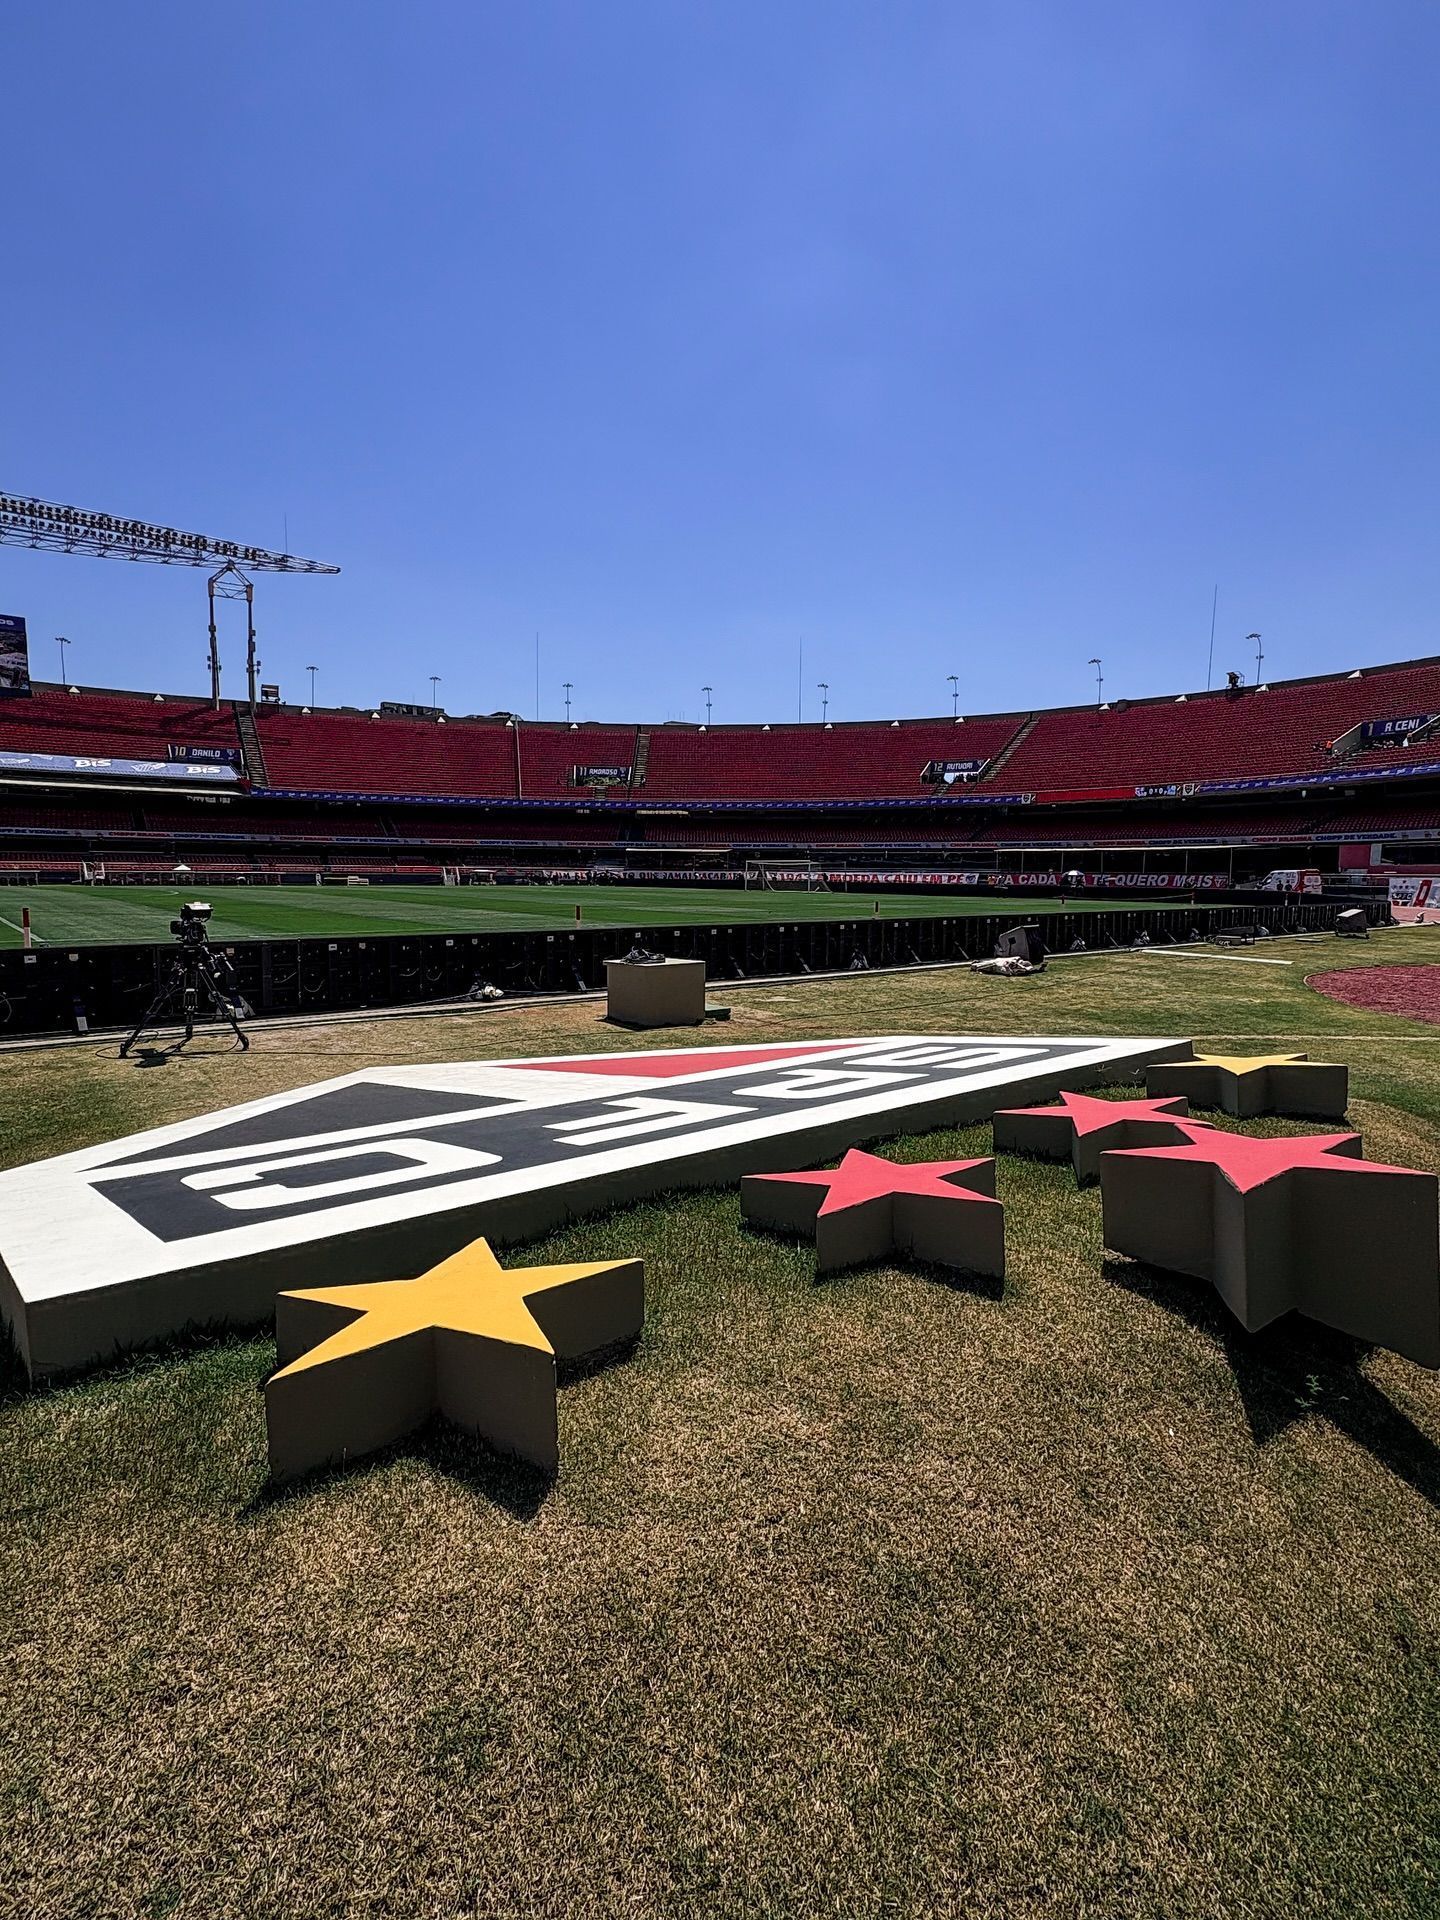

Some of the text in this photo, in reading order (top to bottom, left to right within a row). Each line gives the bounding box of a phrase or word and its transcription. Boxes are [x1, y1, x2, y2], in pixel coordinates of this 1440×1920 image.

[1368, 724, 1374, 736] 1
[1395, 719, 1420, 730] CENI
[174, 746, 187, 756] 10
[192, 749, 221, 758] DANILO
[580, 767, 587, 776] 11
[934, 763, 944, 771] 12
[1019, 874, 1057, 885] CADA
[1115, 874, 1168, 886] QUERO
[180, 1043, 1050, 1210] SPFC
